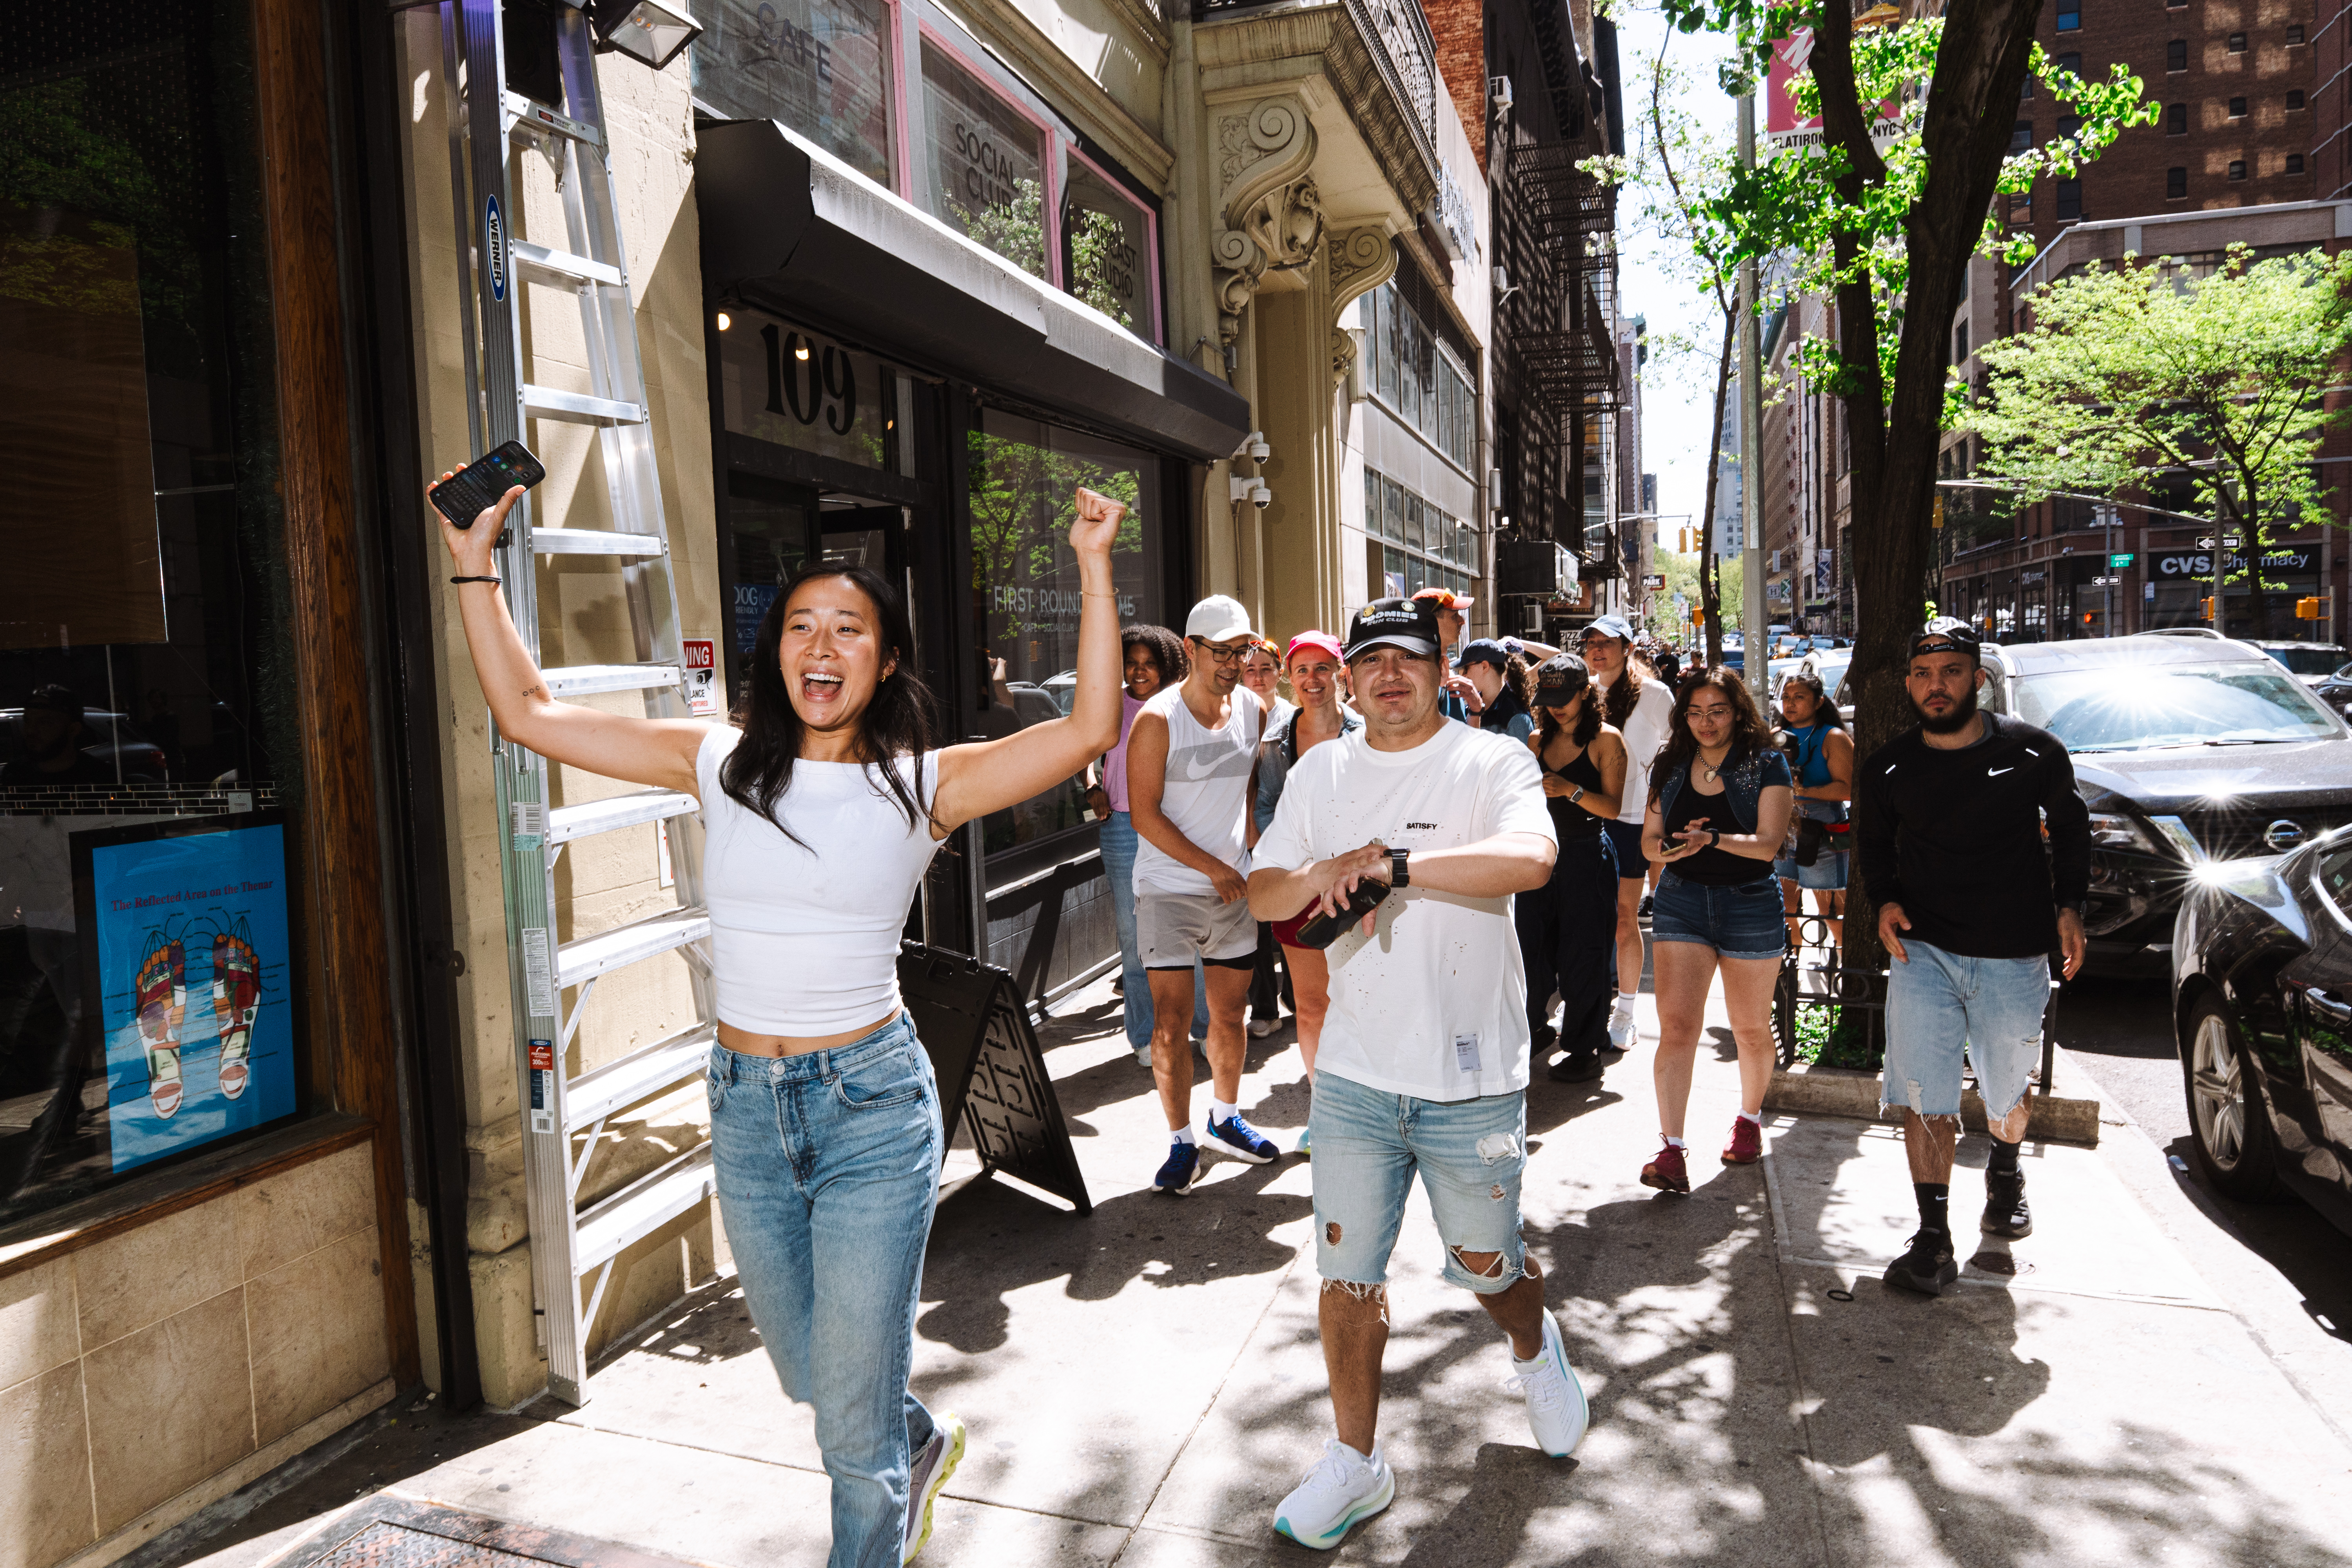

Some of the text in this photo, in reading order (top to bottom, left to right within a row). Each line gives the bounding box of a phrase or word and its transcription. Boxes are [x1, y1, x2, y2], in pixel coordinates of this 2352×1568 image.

[955, 123, 1019, 192] SOCIAL
[966, 167, 1013, 220] CLUB
[490, 218, 502, 281] WERNER
[1082, 211, 1136, 272] PODCAST
[1090, 250, 1133, 298] STUDIO
[760, 323, 856, 436] 109
[2160, 555, 2211, 574] CVS
[735, 606, 758, 614] RIENDLY
[994, 586, 1034, 613] FIRST
[1360, 611, 1418, 624] ZOOMIES
[111, 880, 273, 911] The Reflected Area on the Thenar
